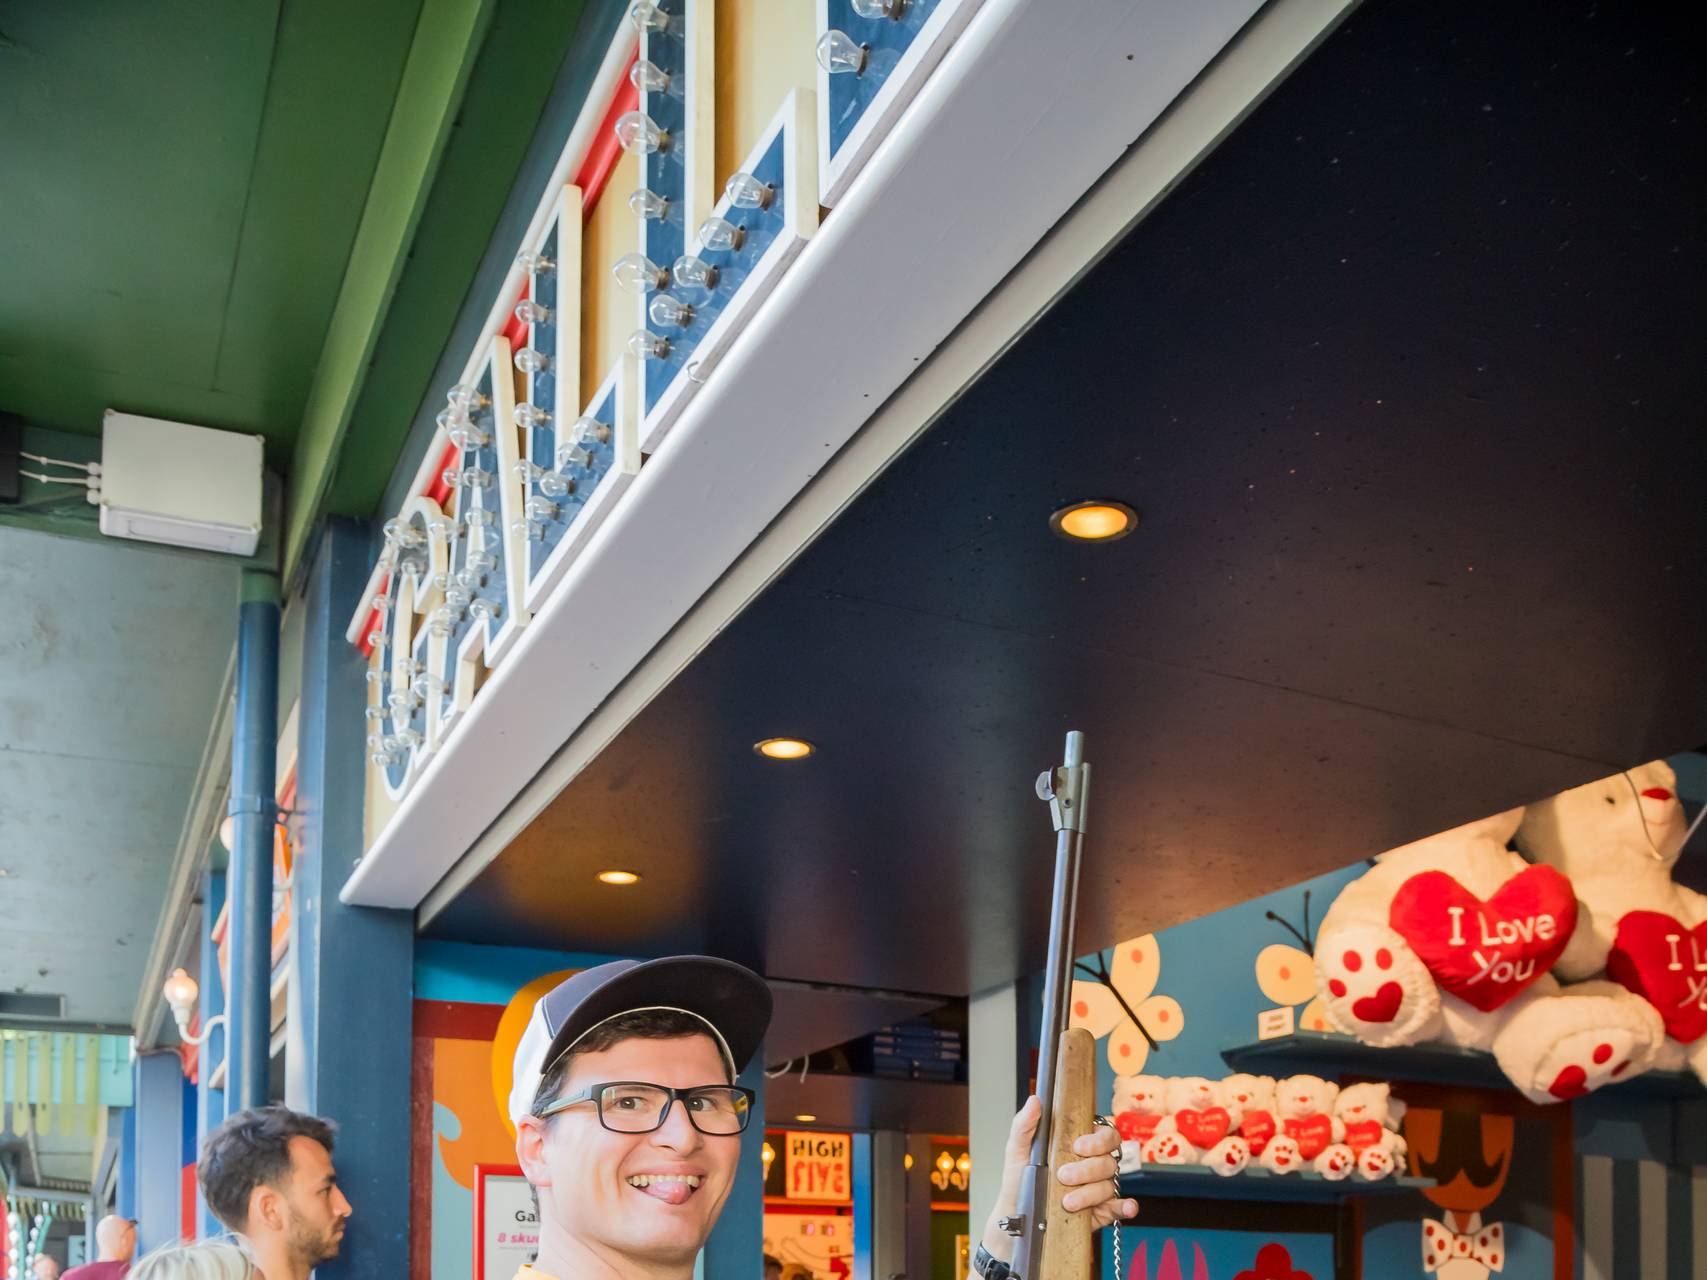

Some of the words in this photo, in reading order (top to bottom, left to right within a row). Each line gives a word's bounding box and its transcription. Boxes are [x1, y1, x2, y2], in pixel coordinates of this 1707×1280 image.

[1447, 906, 1466, 946] I
[1477, 911, 1556, 947] Love
[1466, 950, 1536, 985] You
[1665, 934, 1683, 971] I
[793, 1139, 844, 1158] HIGH
